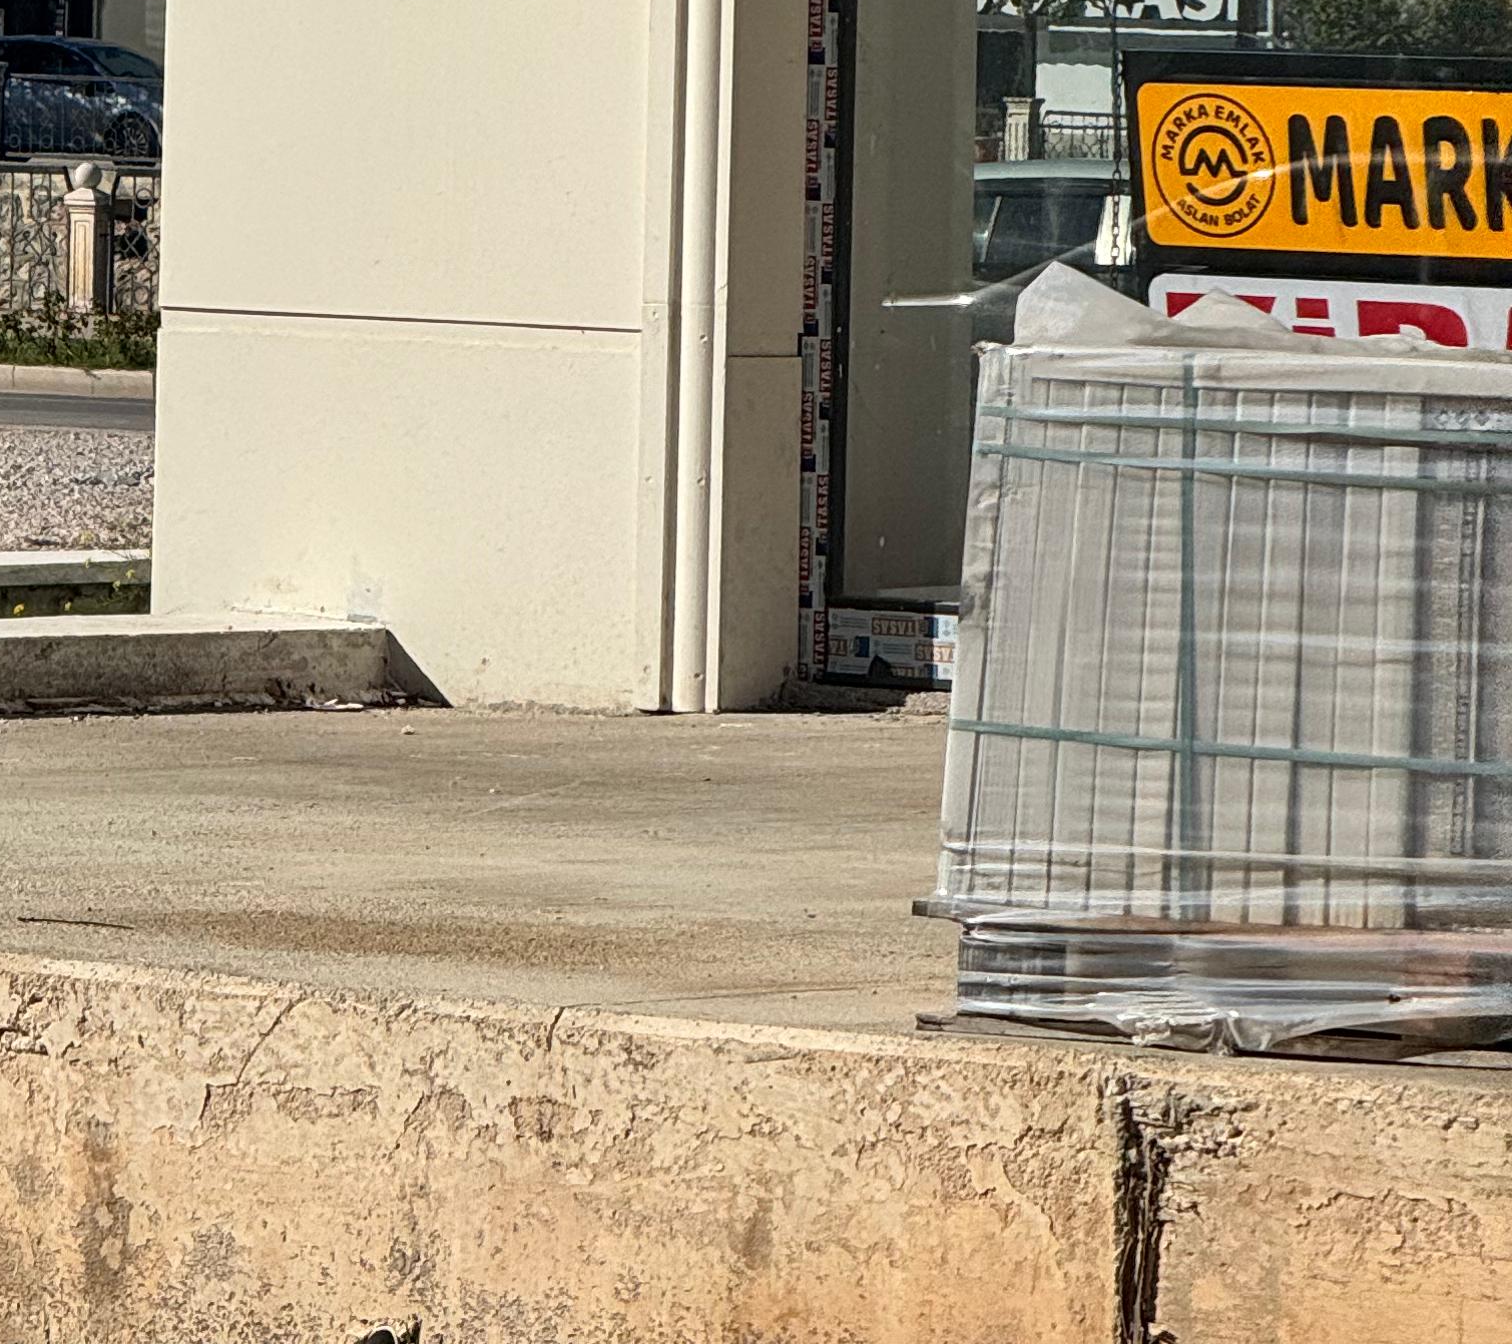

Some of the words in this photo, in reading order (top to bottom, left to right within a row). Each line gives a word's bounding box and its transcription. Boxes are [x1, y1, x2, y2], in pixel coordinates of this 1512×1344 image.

[1160, 104, 1209, 161] MARKA
[1214, 105, 1265, 164] EMLAK
[1176, 198, 1219, 227] ASLAN
[1224, 193, 1261, 226] BOLAT
[873, 618, 915, 636] TASAS
[916, 644, 953, 662] ASAS
